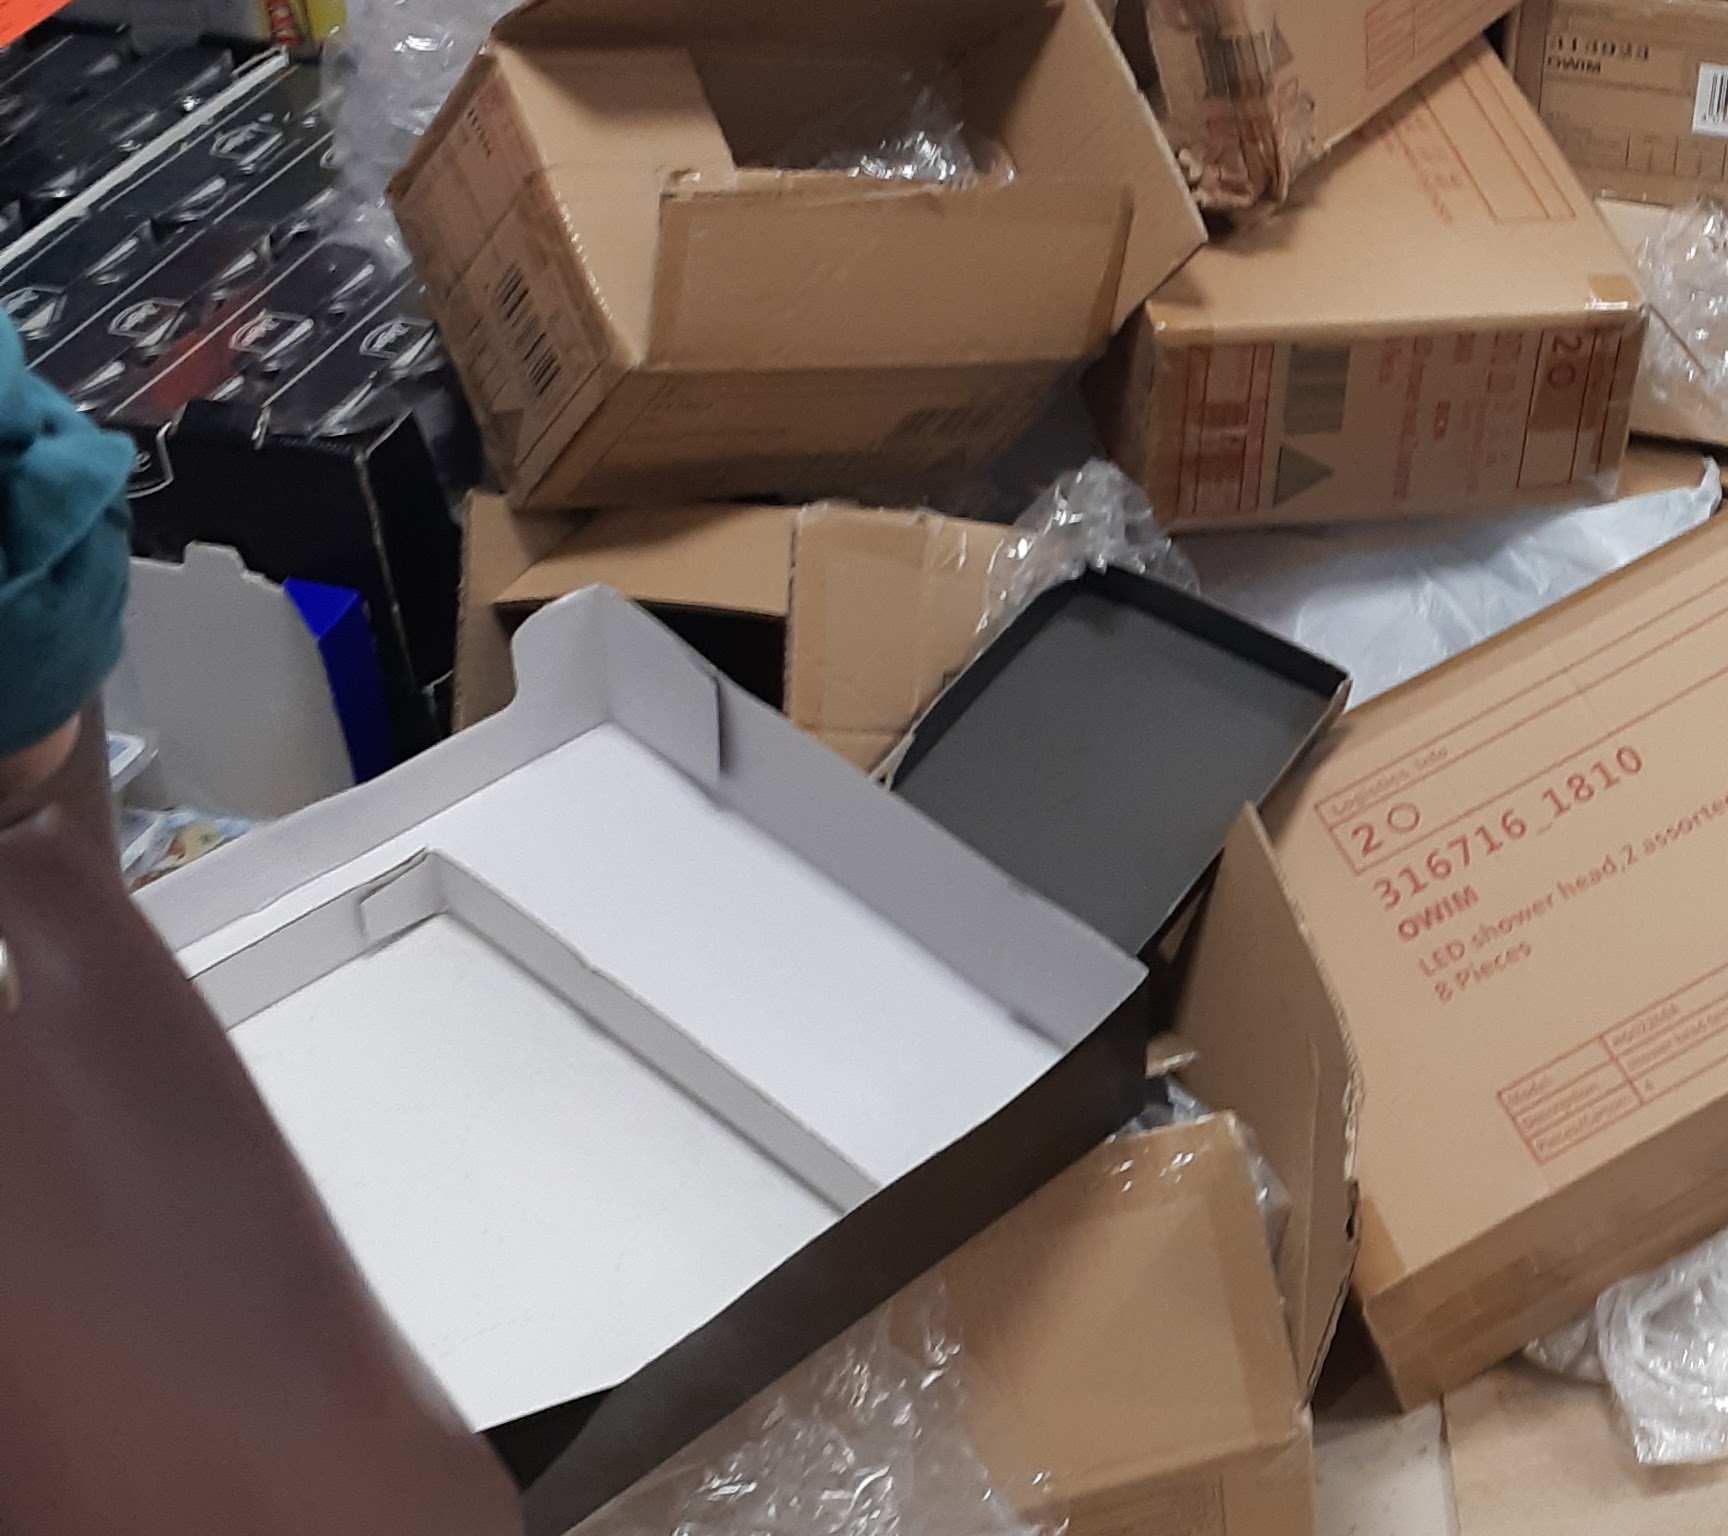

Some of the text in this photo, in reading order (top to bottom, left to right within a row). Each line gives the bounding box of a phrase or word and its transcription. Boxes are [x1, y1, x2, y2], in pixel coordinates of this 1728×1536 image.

[1369, 742, 1651, 916] 316716_1810
[1392, 882, 1482, 944] OWIM
[1415, 937, 1471, 979] LED
[1465, 887, 1559, 951] shower
[1450, 934, 1535, 993] Pieces
